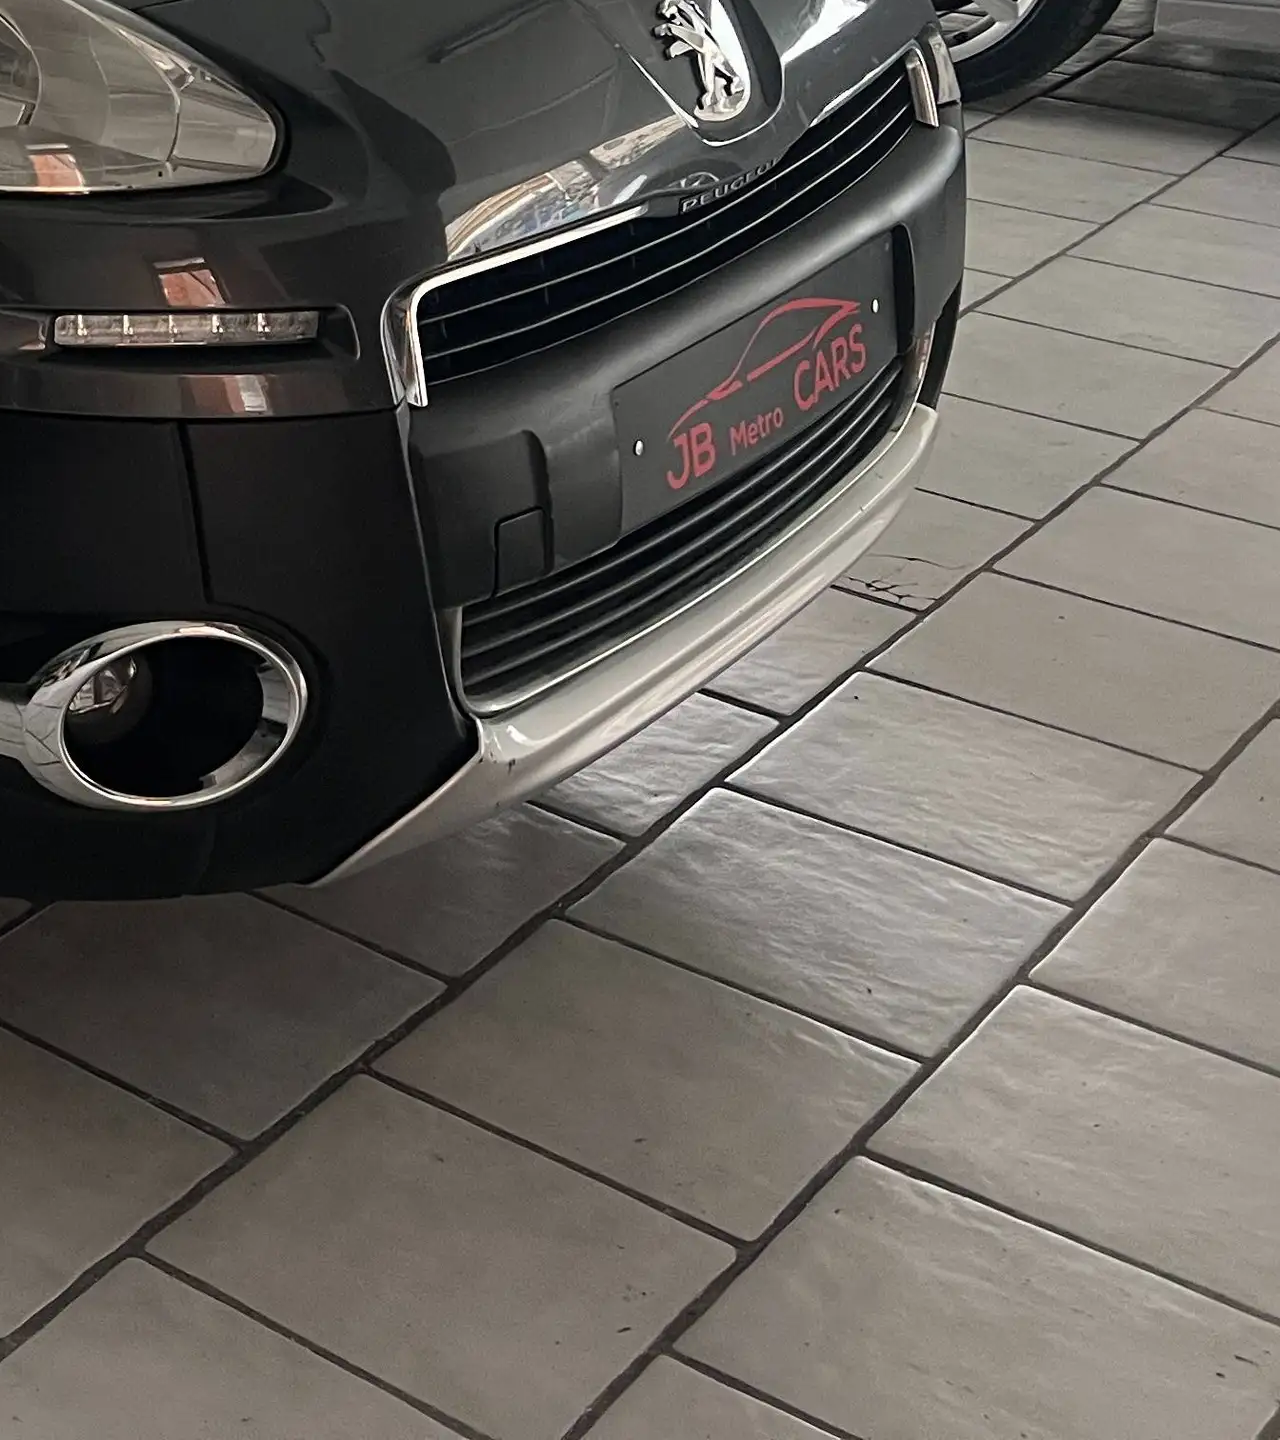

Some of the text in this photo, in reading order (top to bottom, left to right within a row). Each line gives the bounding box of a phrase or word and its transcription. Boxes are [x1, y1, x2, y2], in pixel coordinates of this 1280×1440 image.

[666, 323, 867, 490] JB Metro CARS
